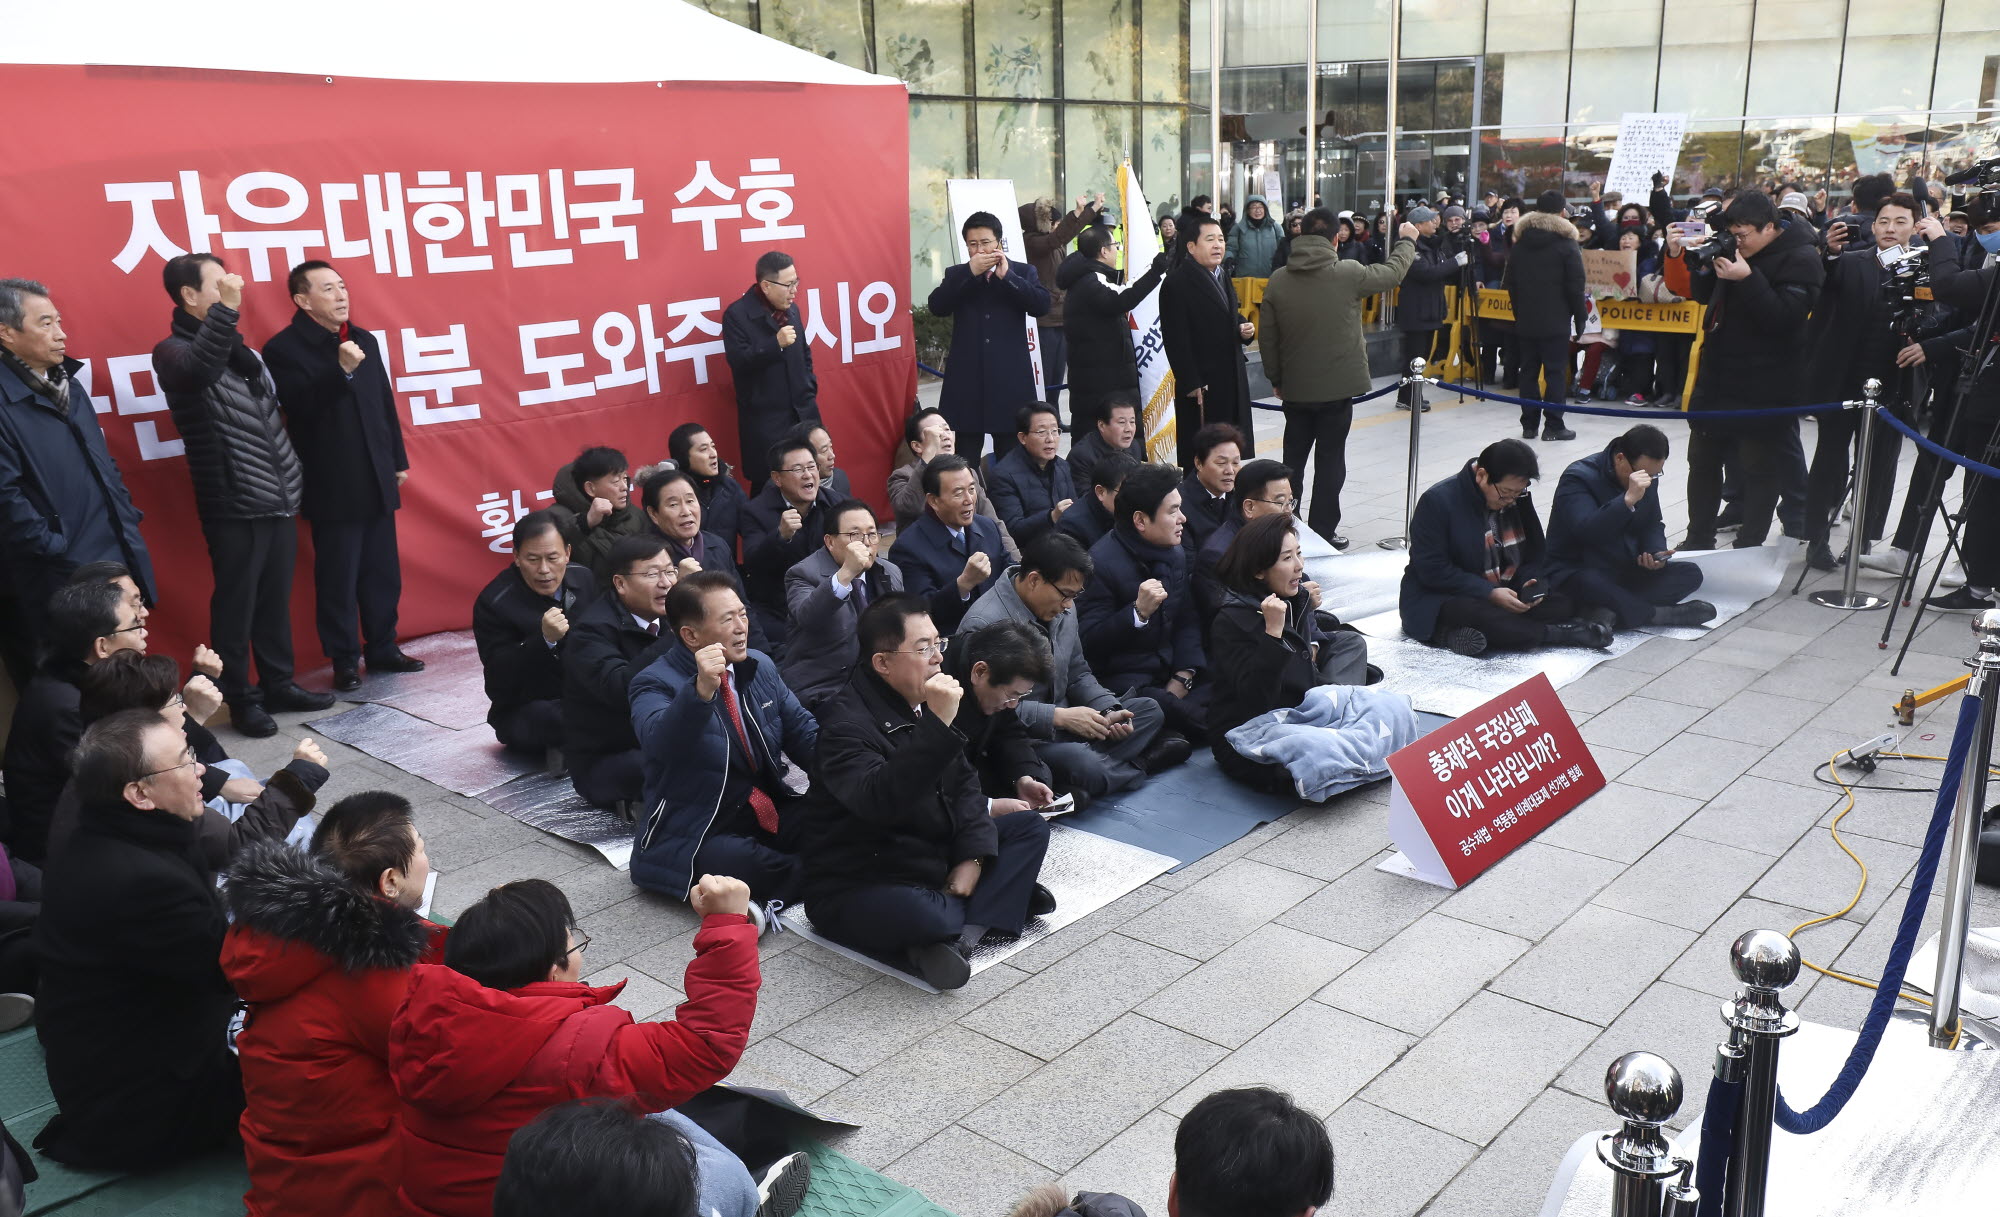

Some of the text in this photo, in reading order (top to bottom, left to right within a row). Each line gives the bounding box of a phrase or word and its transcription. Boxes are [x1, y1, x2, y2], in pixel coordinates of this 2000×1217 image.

[104, 158, 806, 282] 자유대한민국 수호
[518, 281, 901, 407] 도와주시오
[1601, 307, 1690, 323] POLICE LINE
[1428, 699, 1539, 783] 총체적 국정실패
[1445, 732, 1562, 819] 이게 나라입니까?
[1458, 763, 1584, 857] 공수처법 연동형 비례대표제 선거법 철회
